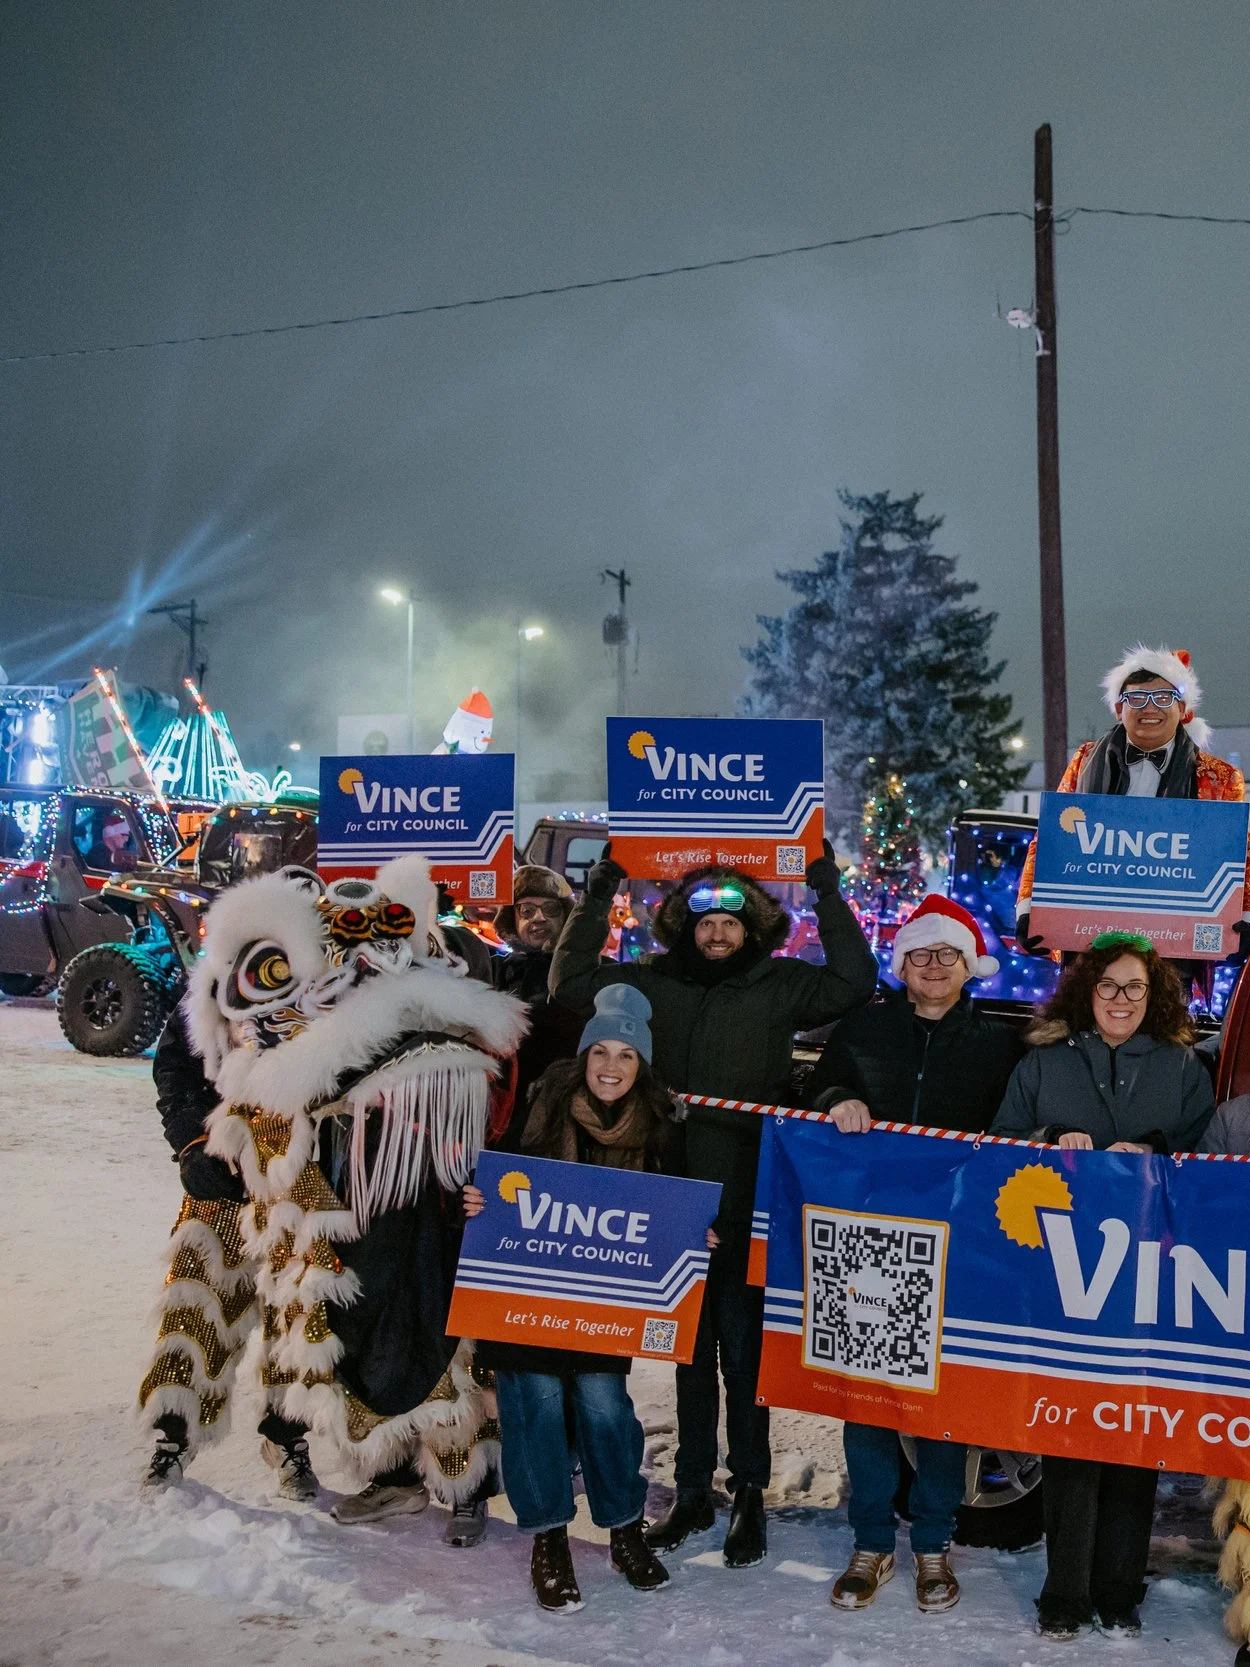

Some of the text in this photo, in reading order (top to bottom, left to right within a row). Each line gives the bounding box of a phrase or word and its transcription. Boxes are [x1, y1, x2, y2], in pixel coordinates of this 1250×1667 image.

[644, 746, 765, 782] VINCE
[352, 781, 461, 814] VINCE
[637, 788, 774, 802] for CITY COUNCIL
[344, 819, 469, 834] for CITY COUNCIL
[1075, 821, 1190, 860] VINCE
[687, 852, 712, 864] Rise
[715, 852, 769, 866] Together
[1061, 861, 1197, 880] for CITY COUNCIL
[1134, 927, 1186, 941] Together
[517, 1188, 650, 1244] VINCE
[496, 1237, 653, 1267] for CITY COUNCIL
[853, 1292, 887, 1307] VINCE
[541, 1315, 570, 1330] Rise
[574, 1318, 635, 1338] Together
[812, 1381, 829, 1392] Paid
[829, 1383, 838, 1394] for
[846, 1391, 874, 1402] Friends
[874, 1394, 883, 1404] of
[1026, 1397, 1078, 1428] for
[1092, 1401, 1185, 1439] CITY
